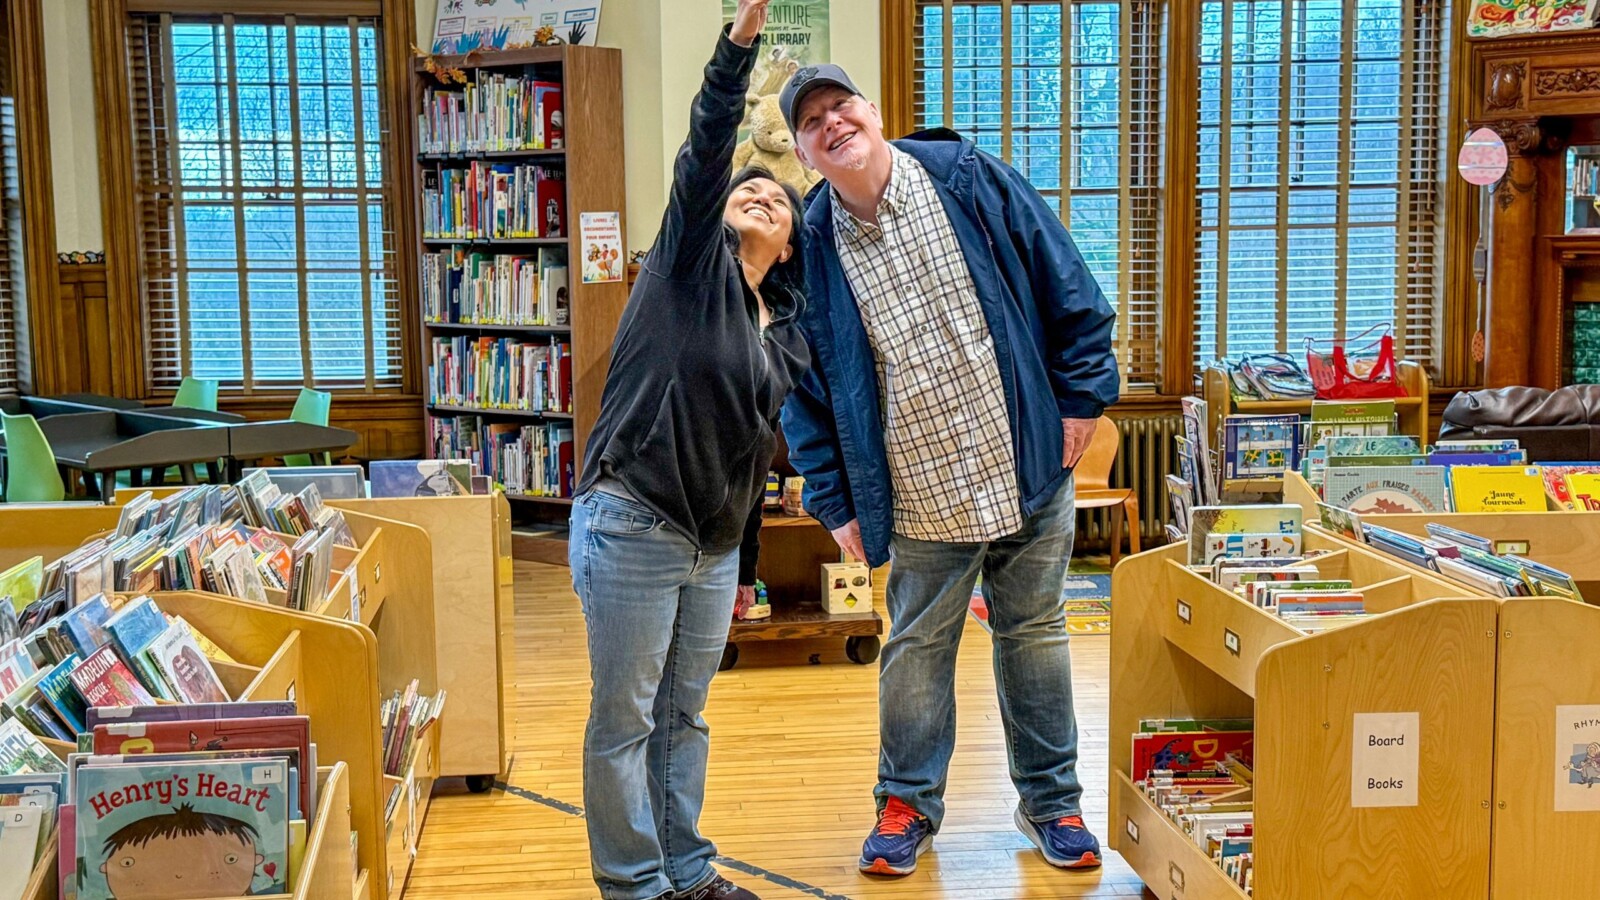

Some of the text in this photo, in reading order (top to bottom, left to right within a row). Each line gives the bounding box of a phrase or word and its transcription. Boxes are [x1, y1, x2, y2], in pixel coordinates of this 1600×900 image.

[766, 4, 812, 28] ENTURE
[771, 33, 811, 45] LIBRARY
[1365, 441, 1377, 451] LE
[1341, 485, 1363, 503] TARTE
[1382, 480, 1410, 492] FRAISES
[77, 649, 117, 691] MADELIN
[86, 681, 110, 705] RESCUE
[1368, 734, 1404, 747] Board
[263, 769, 272, 779] H
[1367, 777, 1404, 790] Books
[89, 773, 270, 820] Henry's Heart
[14, 813, 23, 822] D
